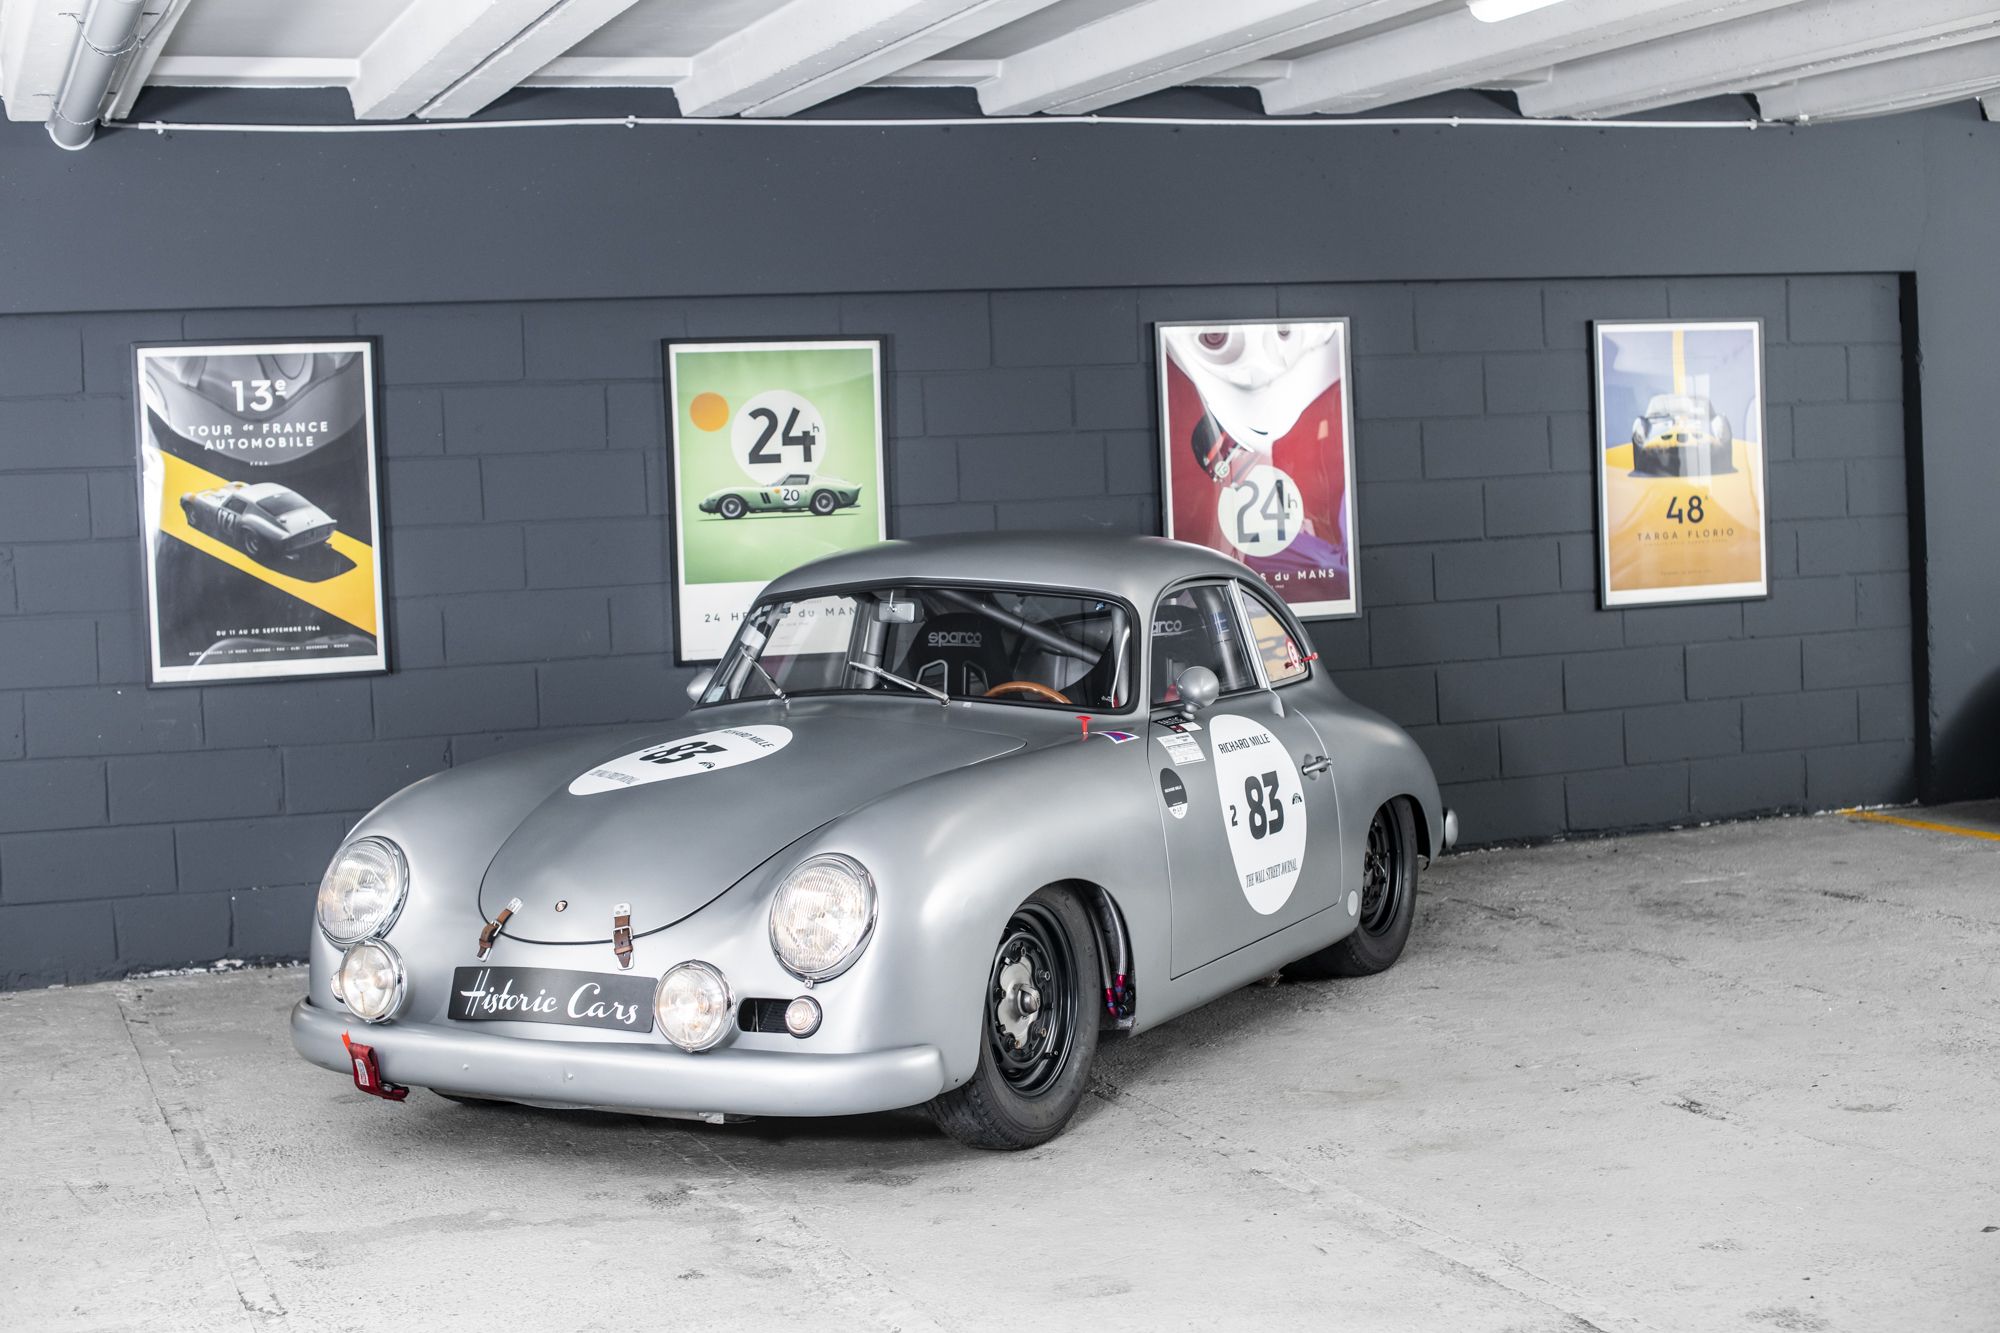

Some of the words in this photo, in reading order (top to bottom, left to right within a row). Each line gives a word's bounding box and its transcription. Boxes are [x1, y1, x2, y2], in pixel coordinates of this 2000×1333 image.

[188, 425, 233, 437] TOUR
[243, 423, 254, 431] de
[262, 421, 329, 434] FRANCE
[204, 436, 315, 450] AUTOMOBILE
[783, 489, 800, 501] 20
[1637, 531, 1678, 541] TARGA
[1687, 527, 1734, 538] FLORIO
[1274, 572, 1290, 581] du
[1297, 568, 1335, 580] MANS
[704, 614, 720, 623] 24
[798, 609, 815, 618] du
[825, 607, 855, 616] MAN
[262, 626, 302, 634] SEPTEMBRE
[1152, 619, 1182, 633] arco
[927, 631, 982, 647] sparco
[1217, 738, 1250, 754] RICHARD
[1248, 733, 1271, 746] MILLE
[1229, 804, 1238, 827] 2
[1244, 770, 1285, 840] 83
[460, 968, 558, 1016] Historic
[567, 982, 639, 1025] Cars
